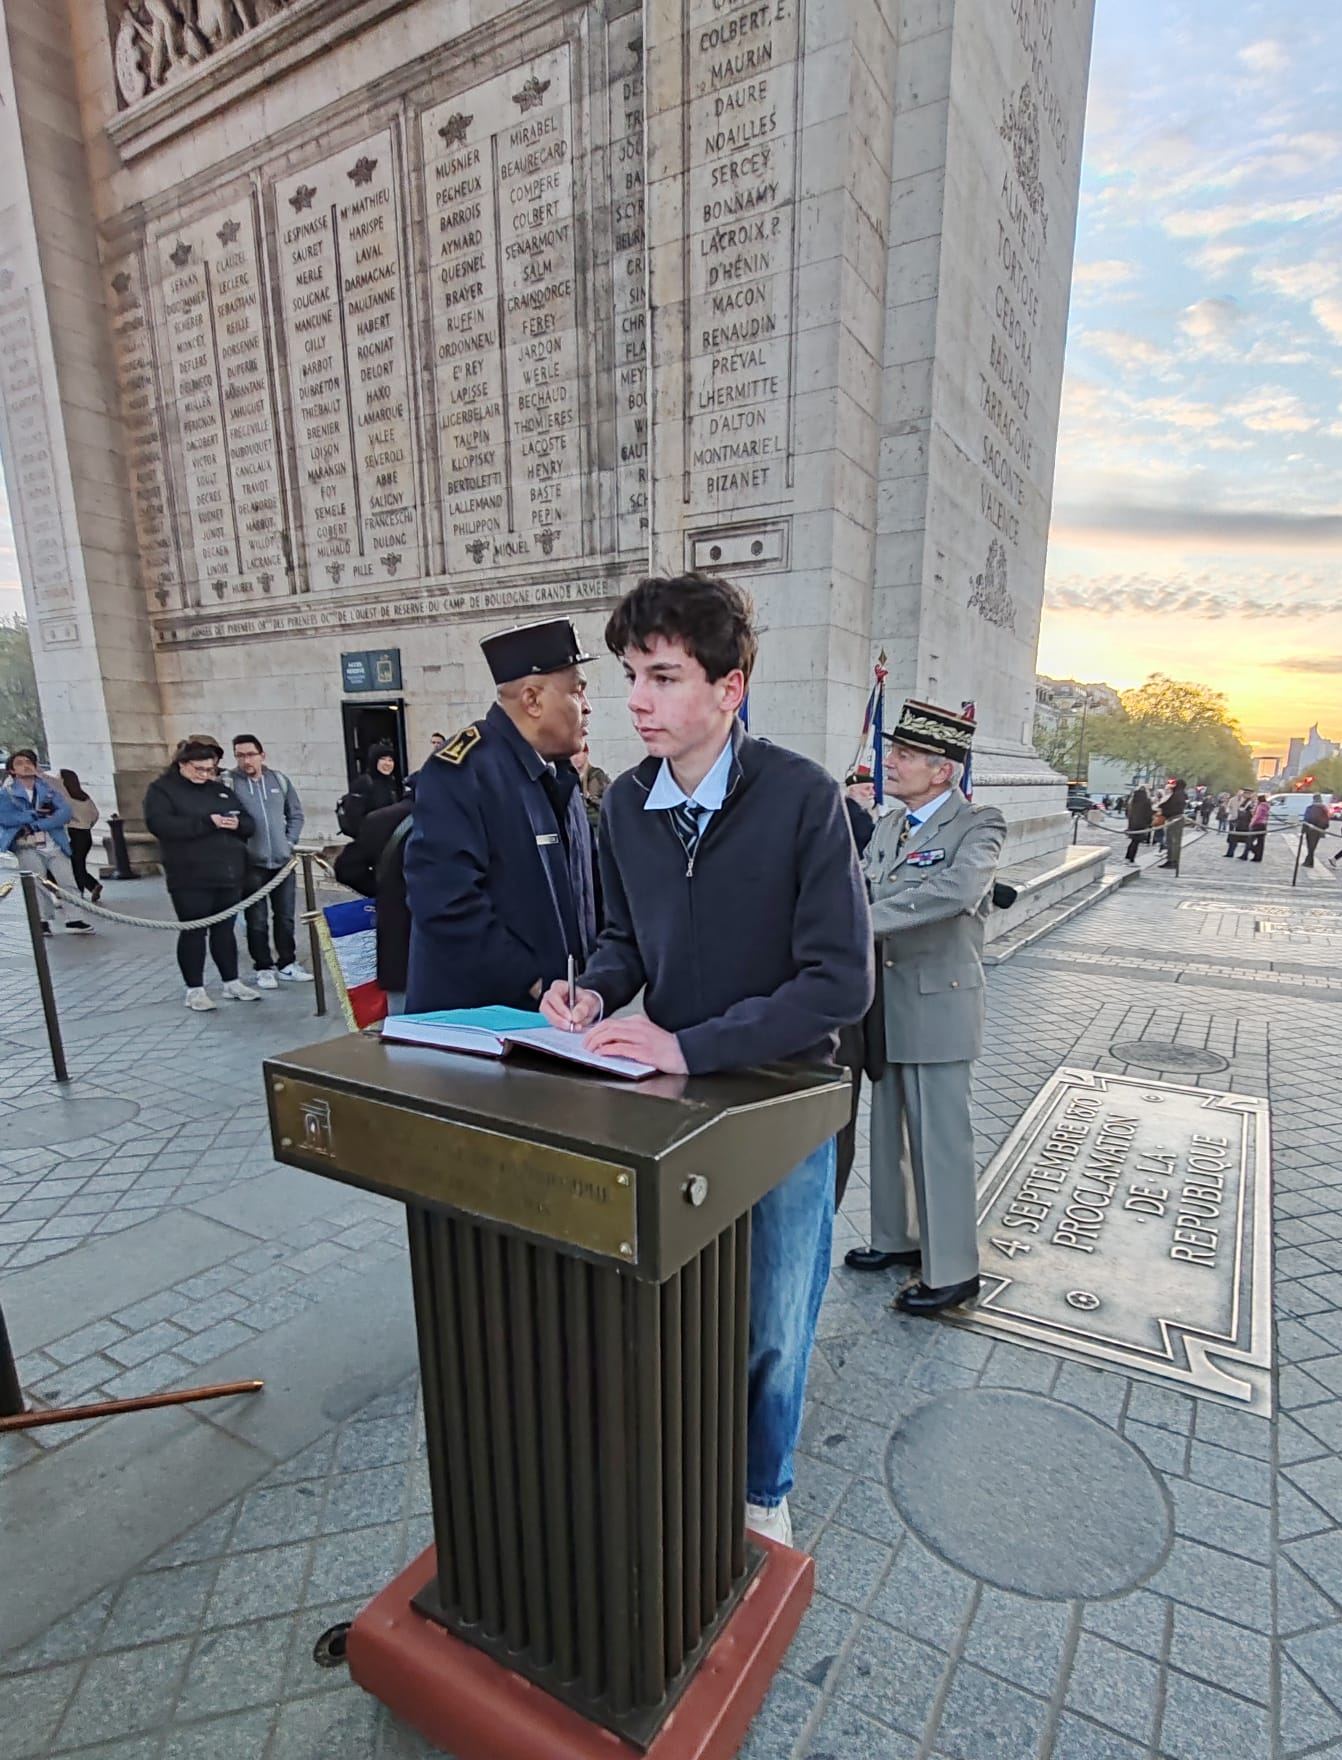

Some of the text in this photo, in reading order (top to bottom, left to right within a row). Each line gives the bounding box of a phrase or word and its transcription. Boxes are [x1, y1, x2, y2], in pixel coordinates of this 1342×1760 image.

[710, 41, 773, 84] MAURIN
[714, 80, 768, 117] DAURE
[510, 117, 558, 147] MIRABEL
[705, 112, 777, 154] NOAILLES
[436, 149, 480, 180] MUSNIER
[711, 149, 771, 187] SERCEY
[436, 176, 482, 207] PECHEUX
[510, 172, 560, 203] COMPERE
[352, 188, 390, 215] MATHIEU
[703, 182, 779, 222] BONNAMY
[440, 203, 481, 232] BARROIS
[513, 200, 560, 231] COLBERT
[284, 215, 328, 244] LESPINASSE
[350, 216, 385, 240] HARISPE
[292, 240, 323, 264] SAURET
[356, 243, 383, 264] LAVAL
[441, 230, 482, 257] AYMARD
[505, 225, 570, 260] SENARMONT
[296, 265, 323, 286] MERLE
[441, 254, 486, 284] QUESNEL
[523, 259, 552, 282] SALM
[219, 272, 249, 295] LECLERC
[446, 282, 483, 308] BRAYER
[349, 287, 396, 315] DAULTANNE
[712, 284, 766, 314] MACON
[357, 313, 390, 336] HABERT
[447, 309, 485, 332] RUFFIN
[522, 314, 556, 335] FEREY
[703, 313, 776, 349] RENAUDIN
[439, 331, 496, 359] ORDONNEAU
[518, 337, 562, 361] JARDON
[361, 360, 394, 382] DELORT
[466, 359, 484, 377] REY
[712, 348, 767, 375] PREVAL
[523, 363, 560, 384] WERLE
[299, 377, 340, 400] DUBRETON
[367, 385, 391, 405] HAXO
[451, 382, 488, 404] LAPISSE
[518, 387, 567, 410] BECHAUD
[699, 376, 778, 408] LHERMITTE
[301, 399, 341, 420] THIEBAULT
[359, 403, 403, 428] LAMARQUE
[307, 421, 341, 440] BRENIER
[514, 409, 573, 435] THOMIERES
[710, 408, 766, 435] D'ALTON
[368, 428, 395, 446] VALEE
[453, 430, 490, 448] TAUPIN
[522, 435, 567, 456] LACOSTE
[311, 443, 340, 460] LOISON
[452, 451, 495, 472] KLOPISKY
[308, 462, 346, 482] MARANSIN
[376, 471, 398, 486] ABBE
[528, 460, 563, 479] HENRY
[707, 468, 770, 494] BIZANET
[321, 485, 337, 499] FOY
[448, 472, 501, 495] BERTOLETTI
[530, 483, 562, 502] BASTE
[315, 503, 347, 520] SEMELE
[449, 495, 502, 516] LALLEMAND
[532, 508, 562, 524] PEPIN
[365, 511, 413, 531] FRANCESCHI
[453, 518, 500, 536] PHILIPPON
[353, 564, 374, 577] PILLE
[381, 606, 390, 617] DE
[394, 602, 425, 616] RESERVE
[429, 600, 440, 612] DU
[444, 598, 465, 610] CAMP
[470, 596, 480, 608] DE
[991, 1095, 1105, 1259] 4 SEPTEMBRE 1870
[1052, 1112, 1141, 1254] PROCLAMATION
[1170, 1132, 1234, 1268] REPUBLIQUE
